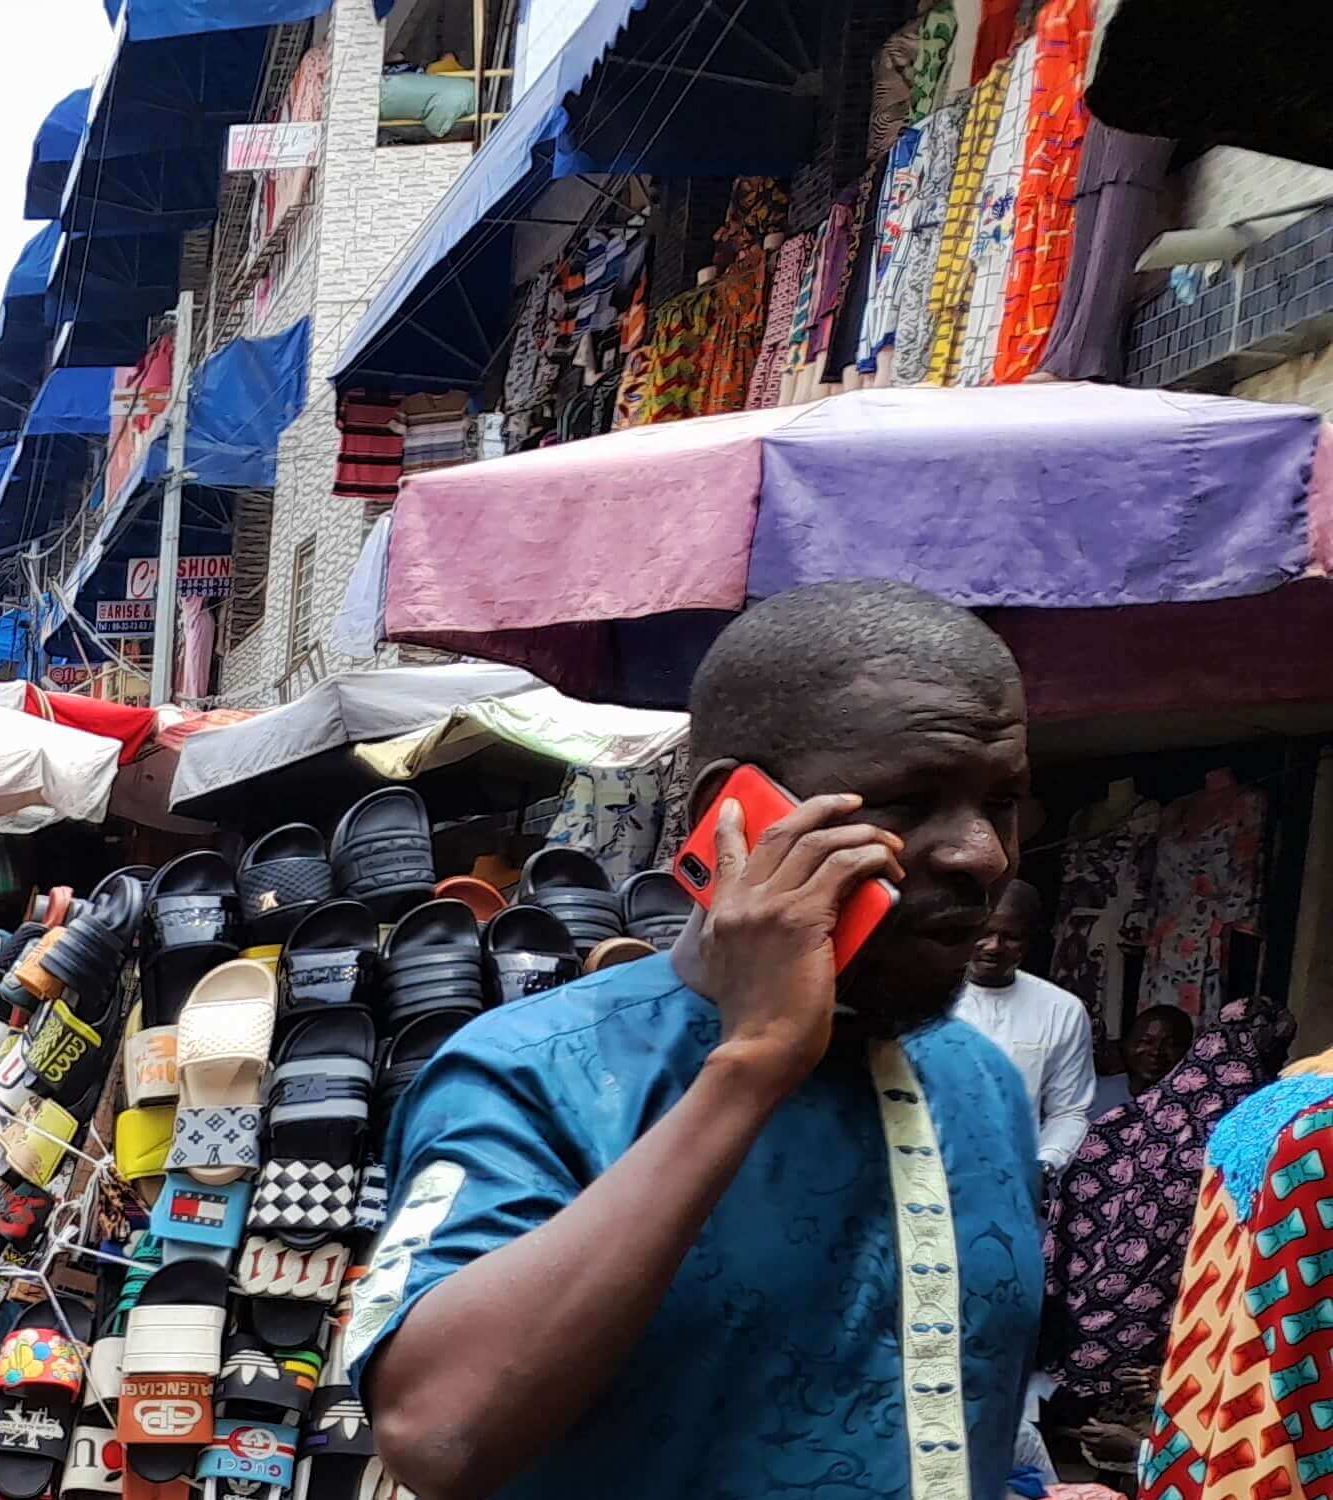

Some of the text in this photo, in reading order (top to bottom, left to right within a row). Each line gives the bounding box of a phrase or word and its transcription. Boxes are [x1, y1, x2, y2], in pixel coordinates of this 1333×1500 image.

[176, 557, 231, 577] SHION
[107, 603, 141, 619] ARISE
[143, 604, 152, 619] &
